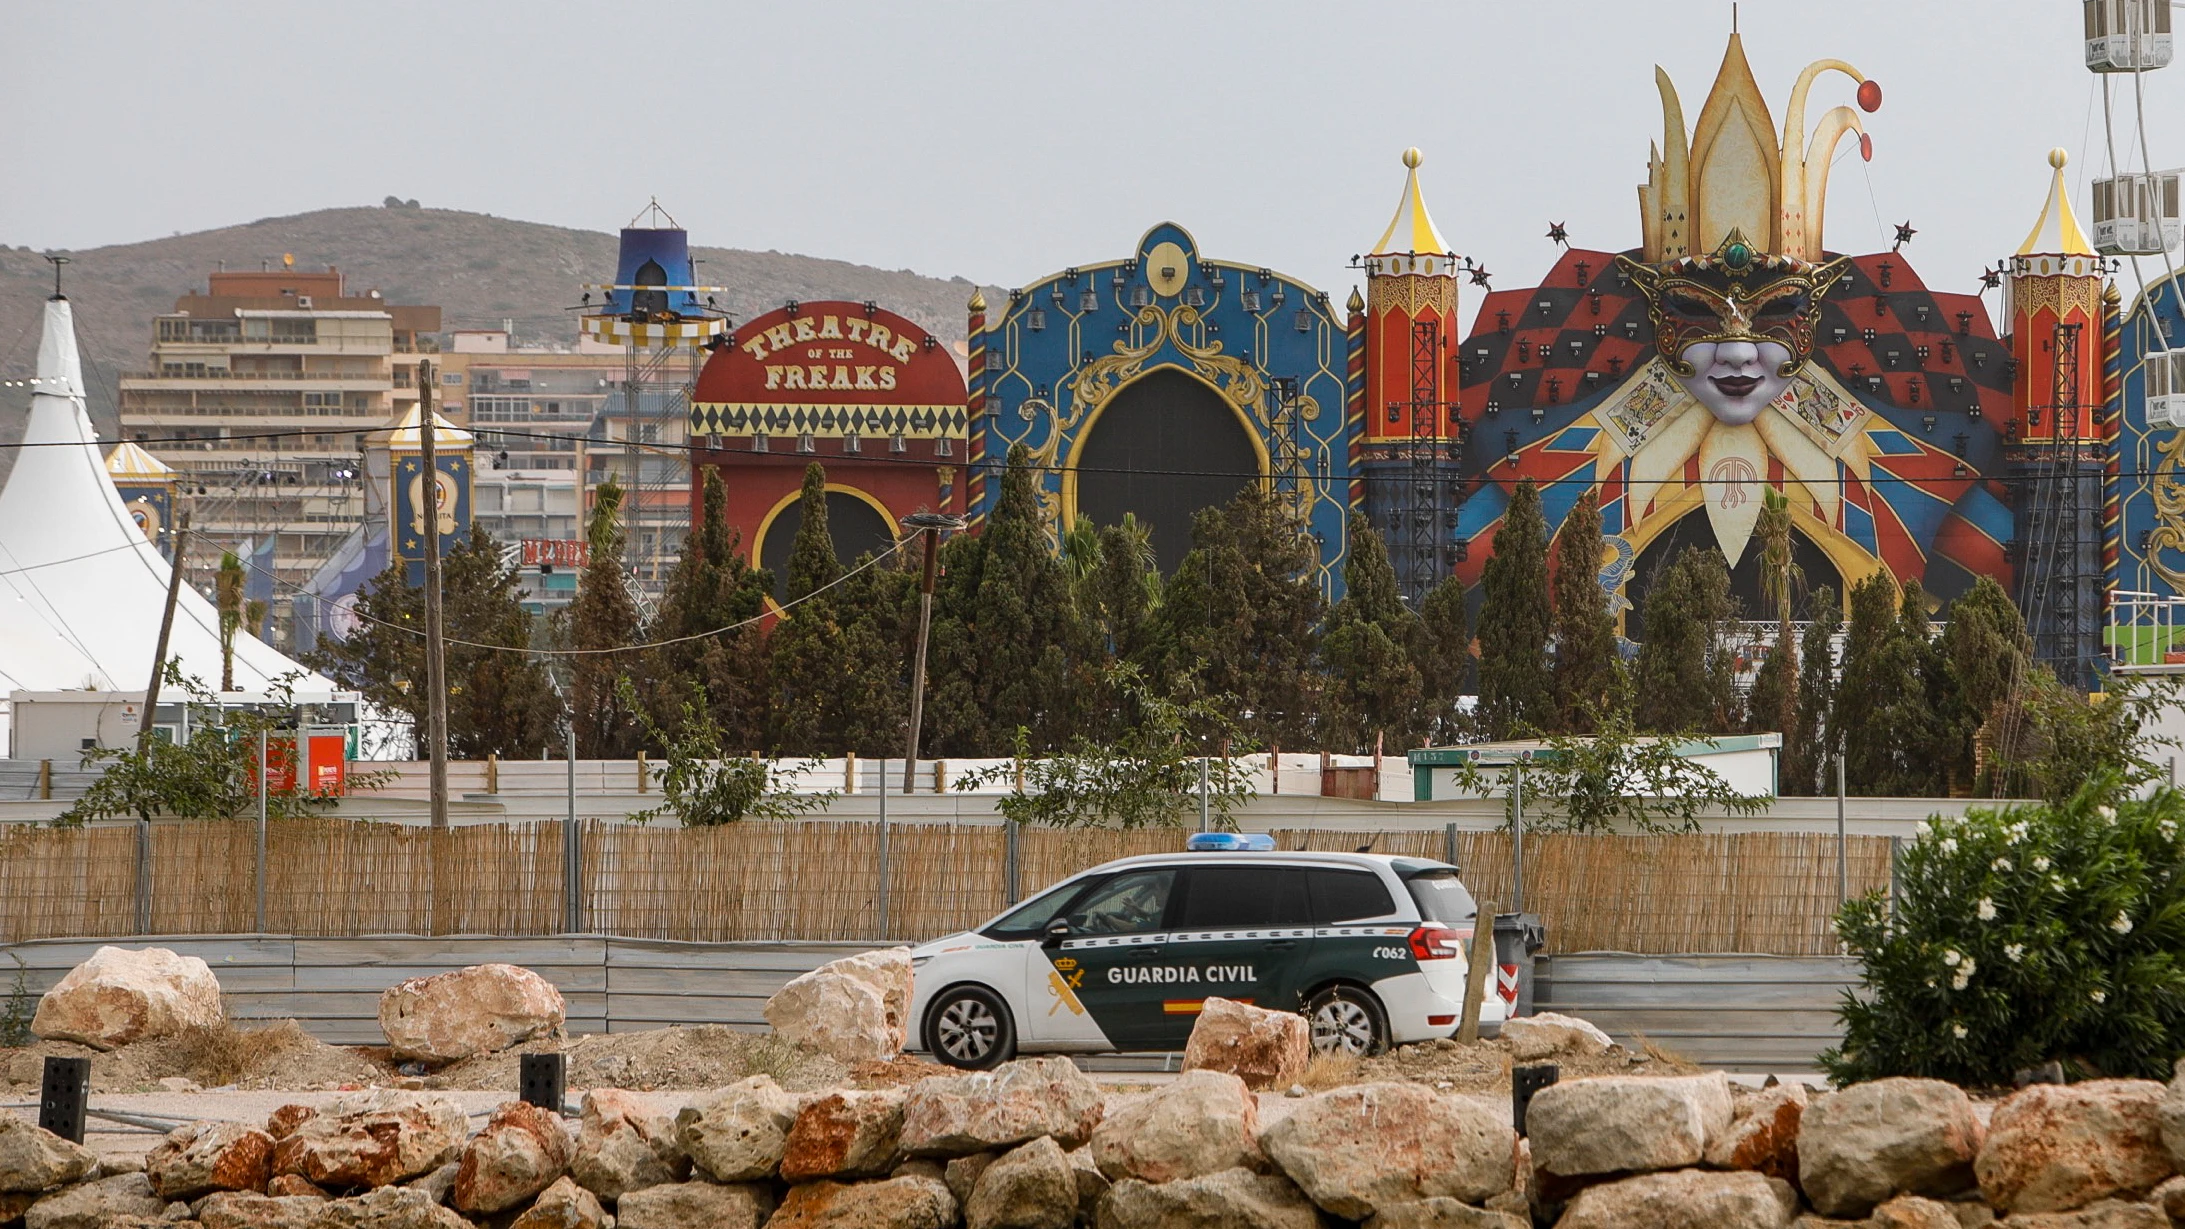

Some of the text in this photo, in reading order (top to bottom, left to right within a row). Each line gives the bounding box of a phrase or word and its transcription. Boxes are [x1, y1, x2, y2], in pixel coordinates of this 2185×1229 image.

[741, 314, 917, 365] THEATRE
[807, 348, 854, 359] OF THE
[764, 364, 897, 391] FREAKS
[416, 512, 452, 520] NITA
[1381, 946, 1407, 959] 062
[1107, 965, 1258, 984] GUARDIA CIVIL
